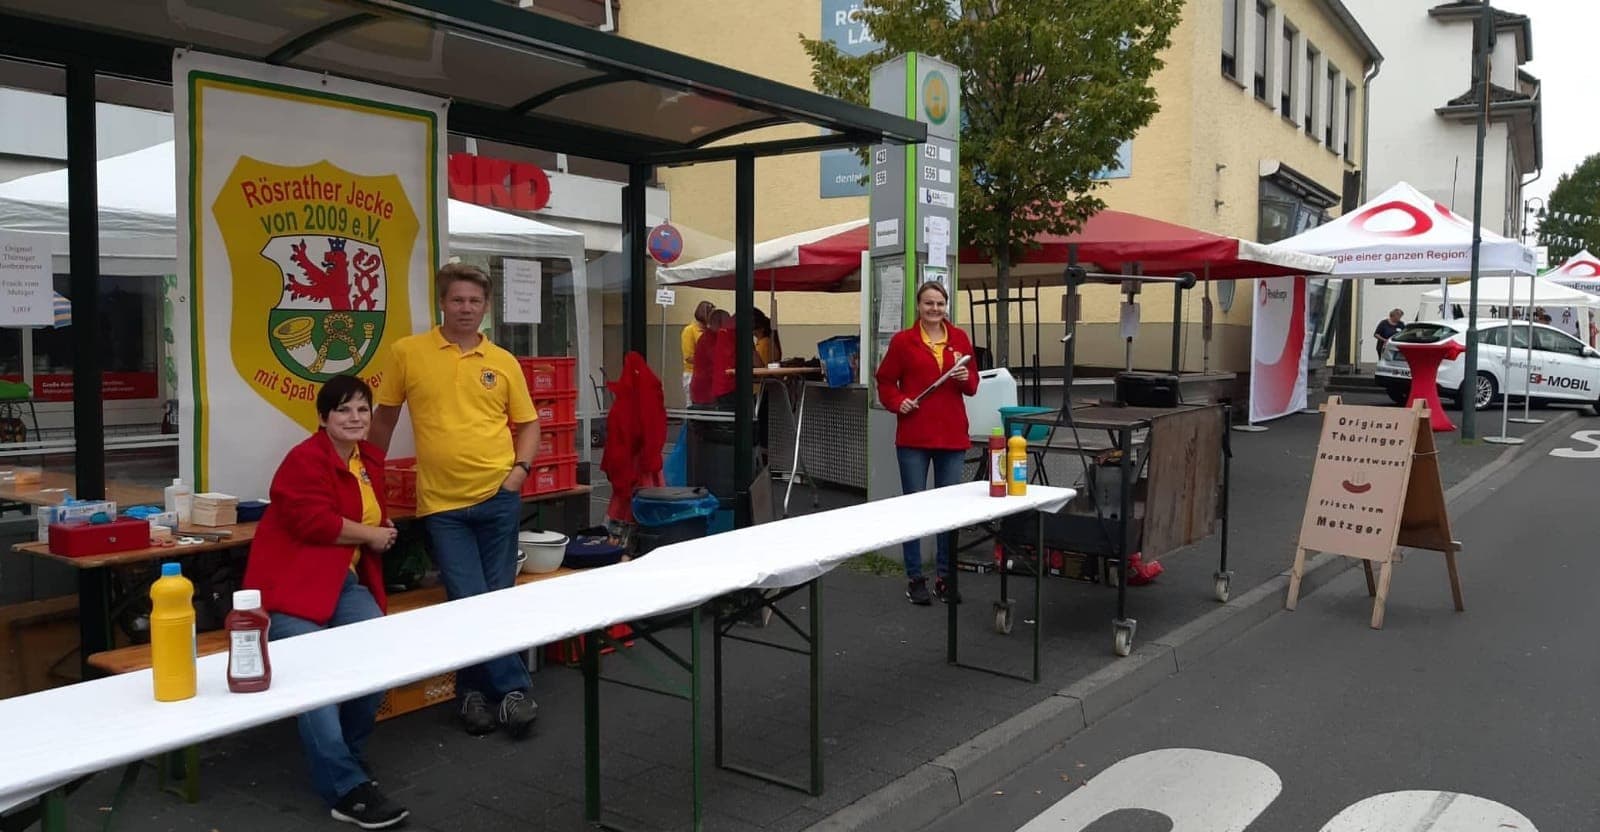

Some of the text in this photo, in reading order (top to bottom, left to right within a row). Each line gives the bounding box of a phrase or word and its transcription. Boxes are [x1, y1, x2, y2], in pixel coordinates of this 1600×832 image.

[240, 173, 394, 219] Rösrather Jecke
[260, 204, 381, 242] von 2009 e.V.
[1355, 252, 1383, 262] einer
[1384, 251, 1424, 263] ganzen
[254, 369, 279, 390] mit
[280, 376, 315, 401] Spaß
[1339, 417, 1399, 430] Original
[1332, 431, 1404, 446] Thüringer
[1320, 452, 1405, 467] Rostbratwurst
[1361, 506, 1384, 514] vom
[1316, 516, 1382, 535] Metzger
